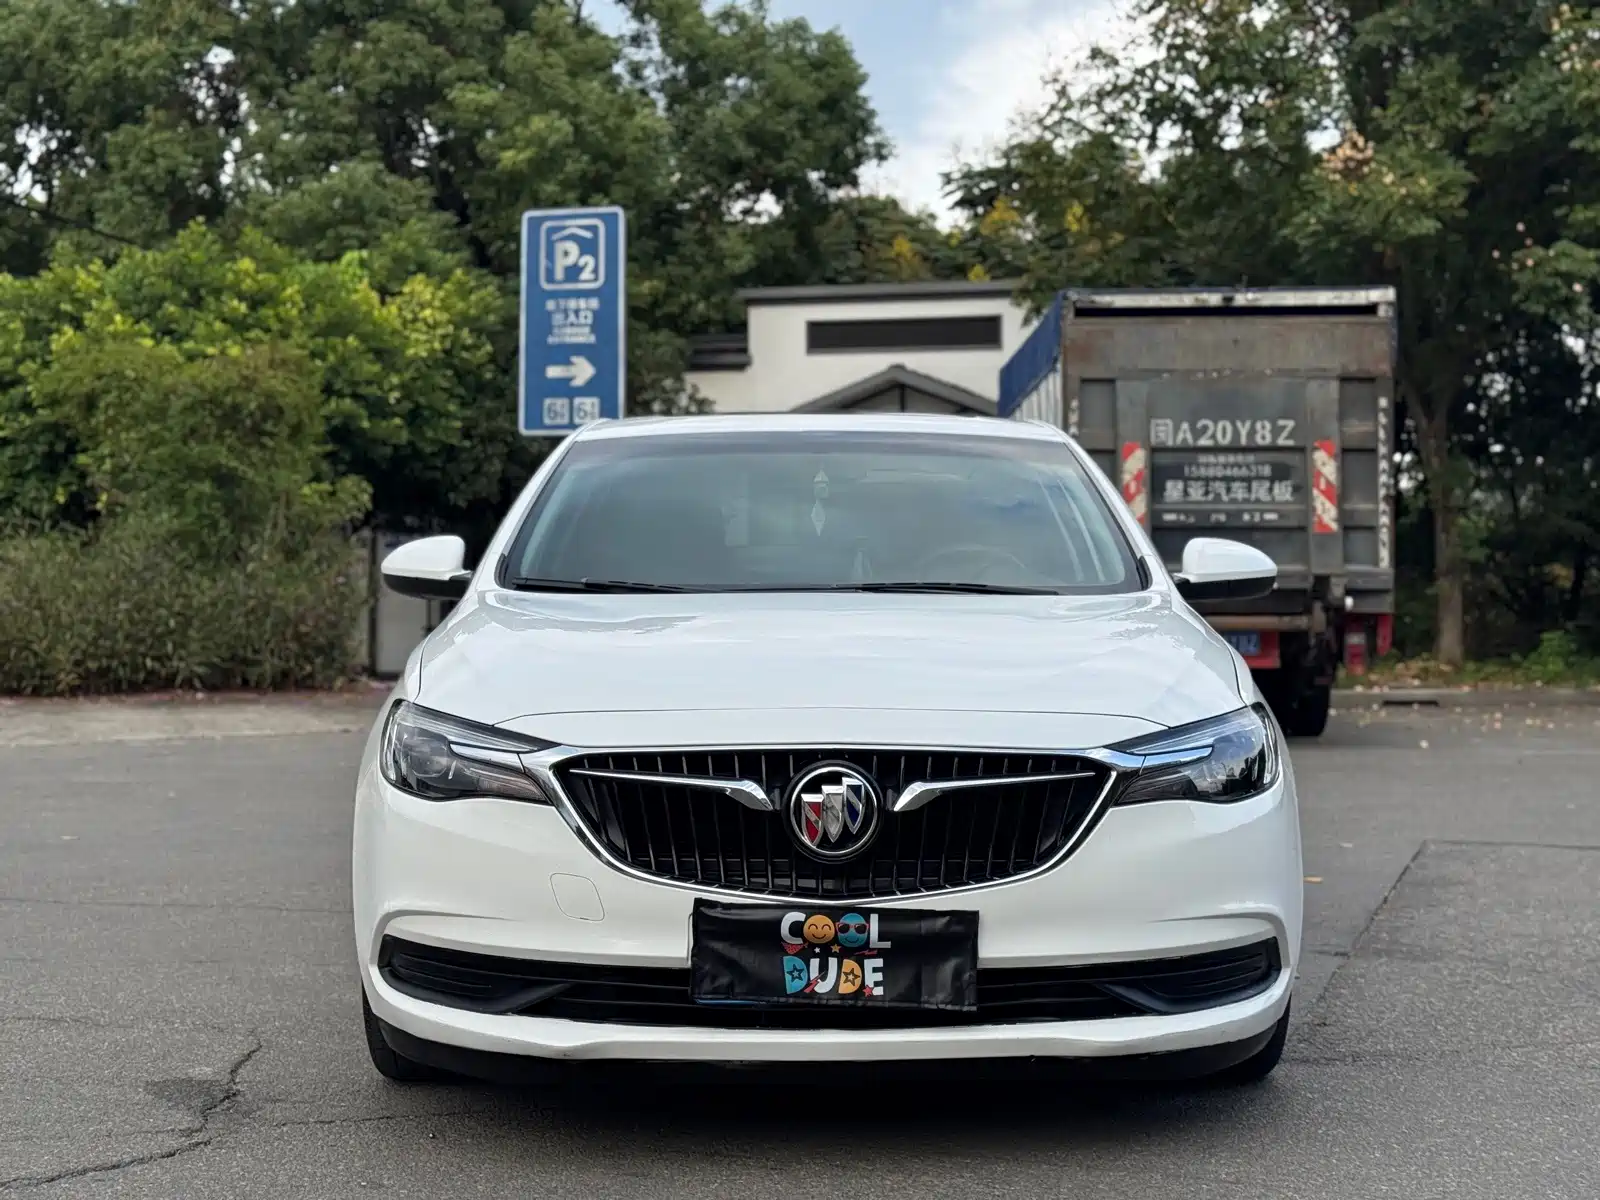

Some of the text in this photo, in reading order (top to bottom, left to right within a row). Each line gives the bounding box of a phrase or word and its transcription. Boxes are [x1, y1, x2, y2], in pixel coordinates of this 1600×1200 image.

[555, 240, 596, 281] P2
[781, 911, 892, 948] COOL
[783, 956, 884, 996] DUDE
